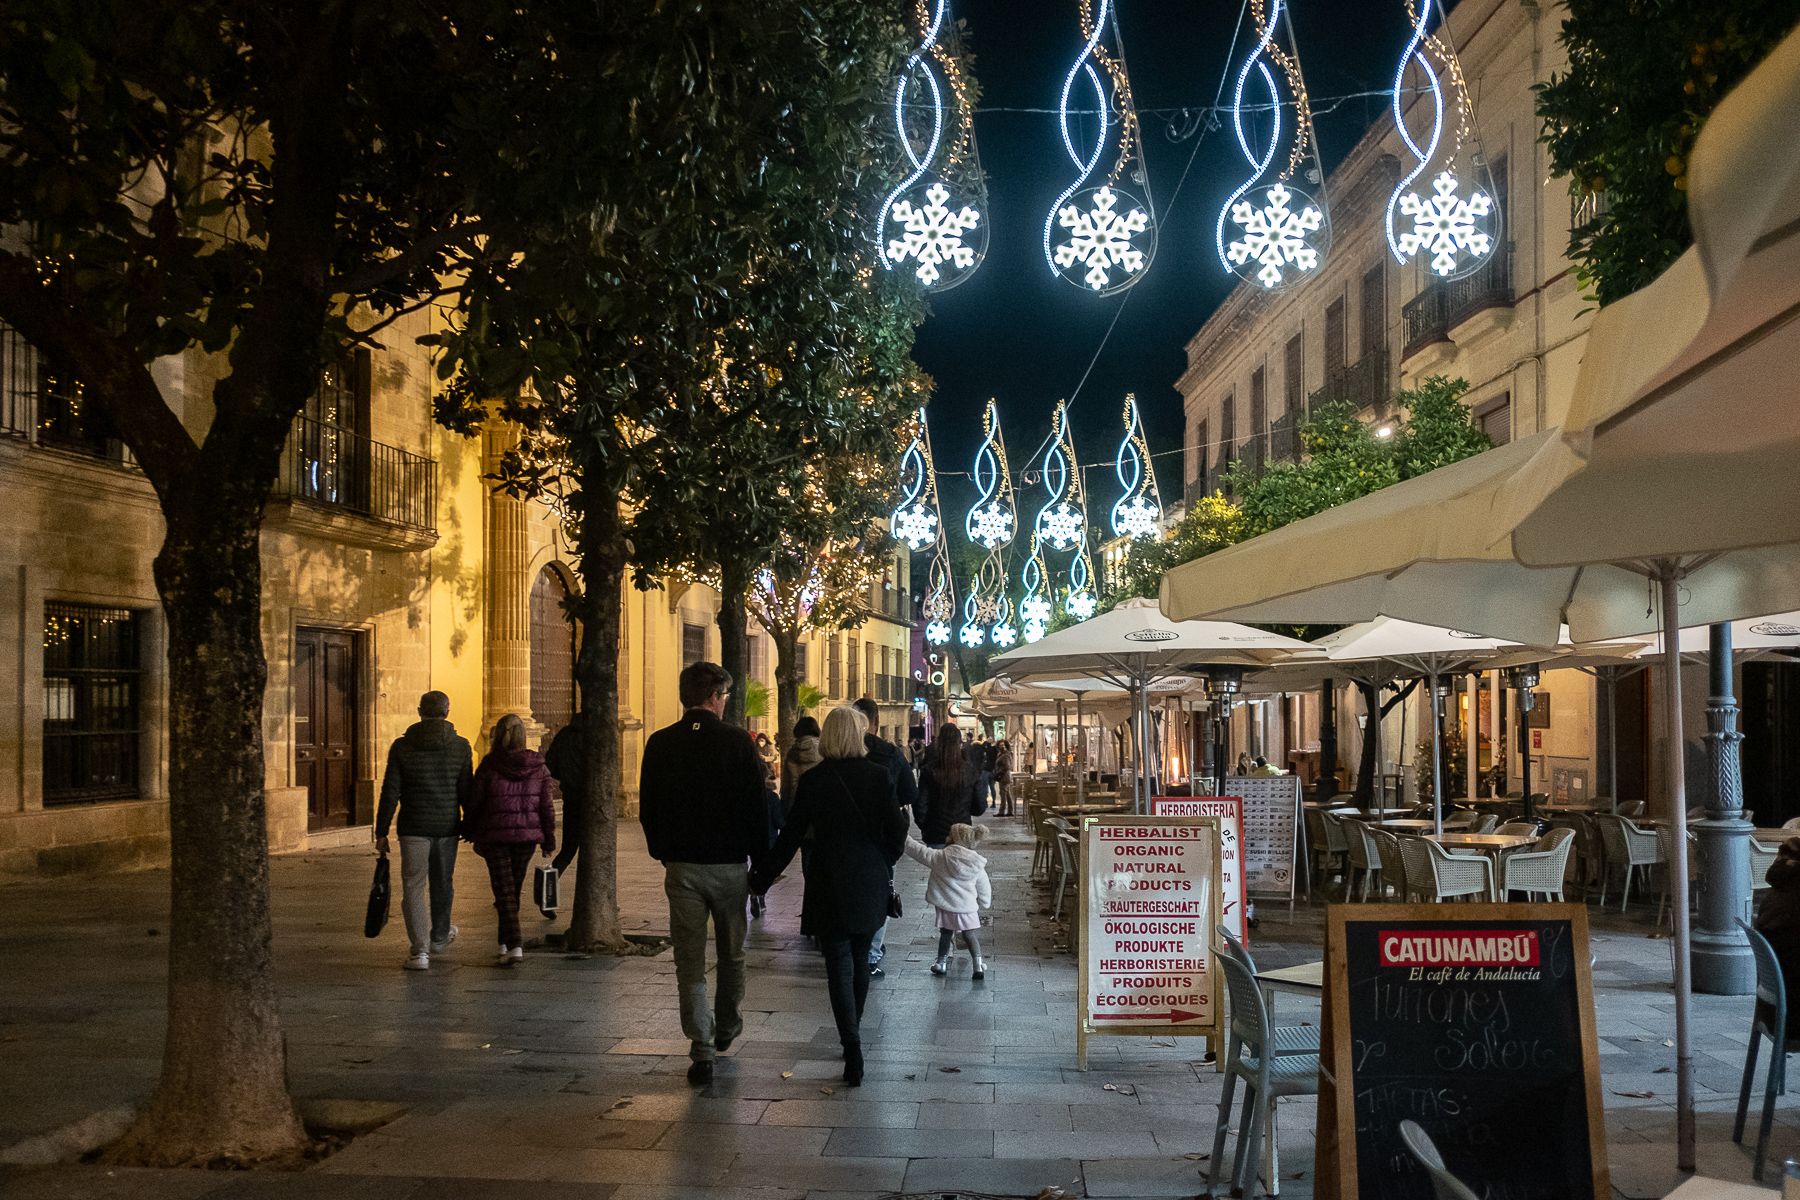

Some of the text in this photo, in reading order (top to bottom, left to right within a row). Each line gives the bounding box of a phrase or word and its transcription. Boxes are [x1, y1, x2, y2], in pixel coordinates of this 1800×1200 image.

[1160, 803, 1236, 818] HERBORISTERIA
[1100, 827, 1201, 838] HERBALIST
[1222, 829, 1236, 843] DE
[1114, 845, 1185, 856] ORGANIC
[1113, 862, 1186, 874] NATURAL
[1104, 918, 1196, 935] ÖKOLOGISCHE
[1115, 941, 1184, 953] PRODUKTE
[1384, 935, 1530, 962] CATUNAMBÚ
[1100, 959, 1205, 970] HERBORISTERIE
[1408, 966, 1541, 985] El café de Andalucía
[1113, 977, 1193, 988] PRODUITS
[1096, 993, 1209, 1006] ÉCOLOGIQUES
